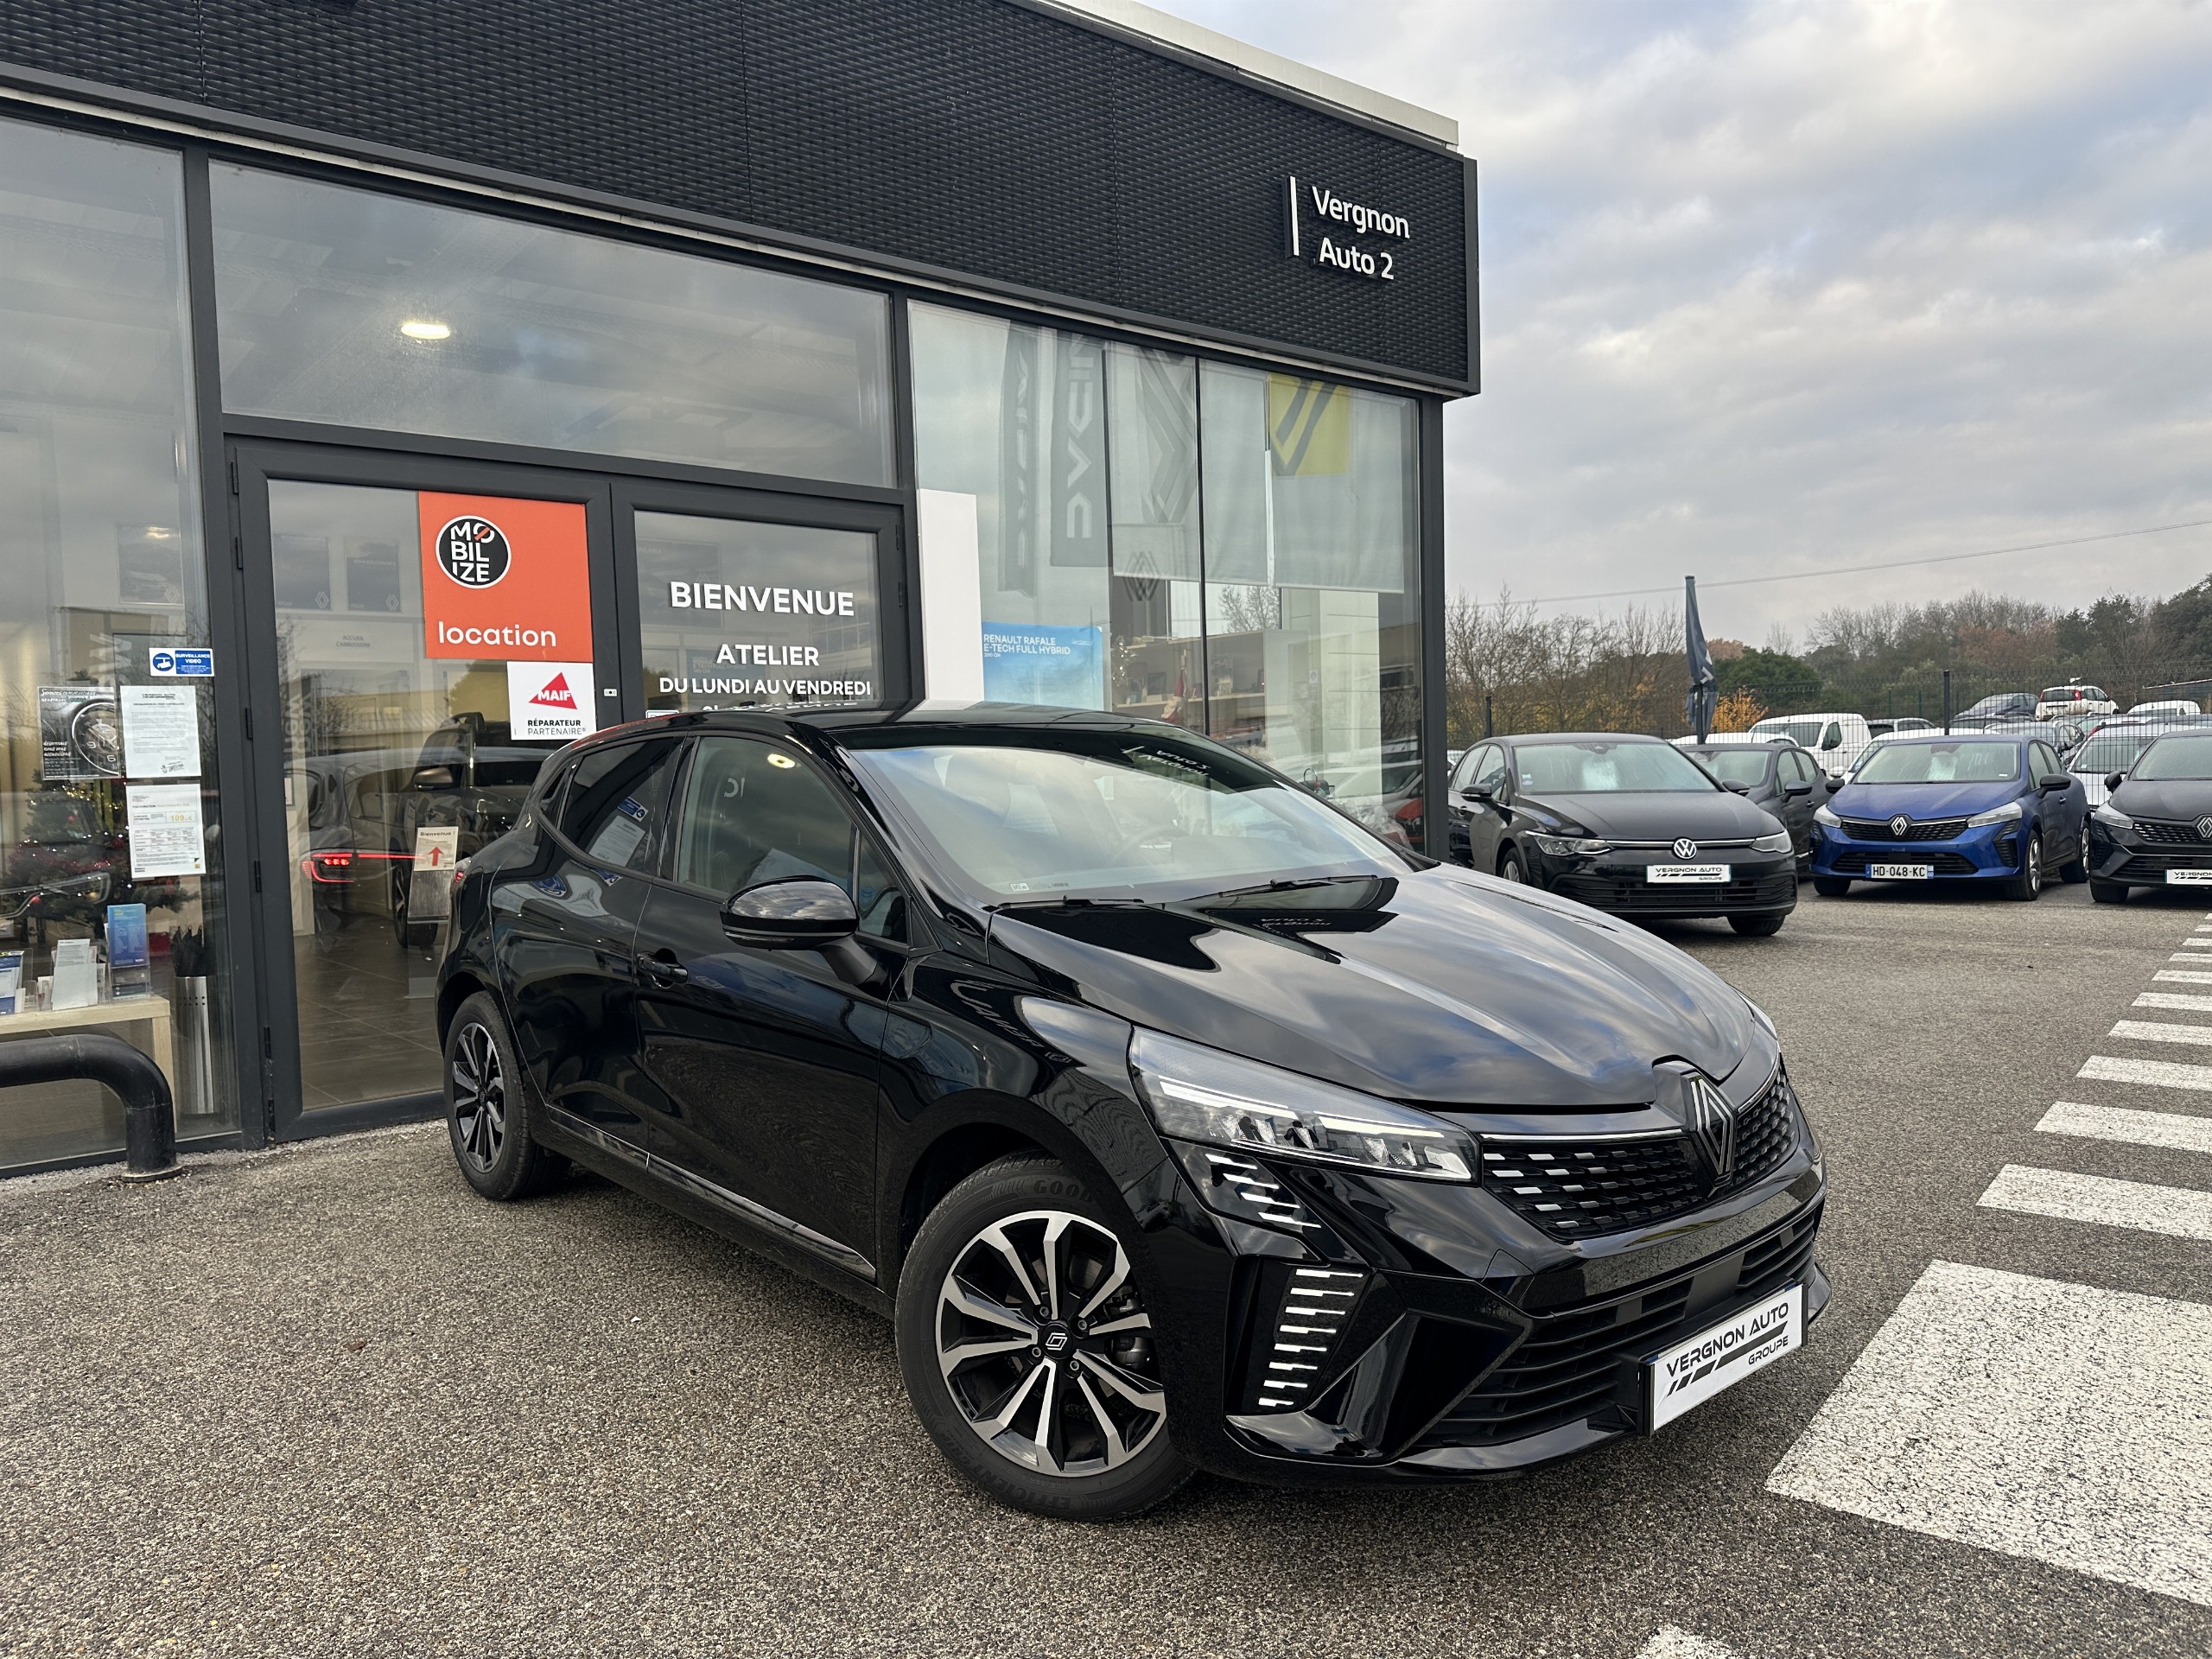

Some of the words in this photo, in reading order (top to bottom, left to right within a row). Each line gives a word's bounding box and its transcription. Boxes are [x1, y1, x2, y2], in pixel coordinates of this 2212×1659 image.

[1312, 186, 1410, 238] Vergnon
[1319, 237, 1375, 275] Auto
[1380, 252, 1395, 280] 2
[671, 582, 855, 616] BIENVENUE
[438, 621, 556, 647] location
[983, 634, 1022, 645] RENAULT
[1024, 637, 1056, 645] RAFALE
[716, 644, 820, 666] ATELIER
[983, 644, 1014, 652] E-TECH
[1017, 645, 1038, 654] FULL
[1039, 646, 1071, 655] HYBRID
[537, 690, 571, 701] MAIF
[659, 677, 688, 693] DU
[692, 678, 750, 694] LUNDI
[753, 679, 779, 695] AU
[783, 680, 871, 696] VENDREDI
[527, 718, 581, 727] RÉPARATEUR
[1872, 866, 1925, 877] HD-048-KC
[1666, 1325, 1745, 1377] VERGNON
[1749, 1302, 1789, 1336] AUTO
[1748, 1335, 1789, 1365] GROUPE
